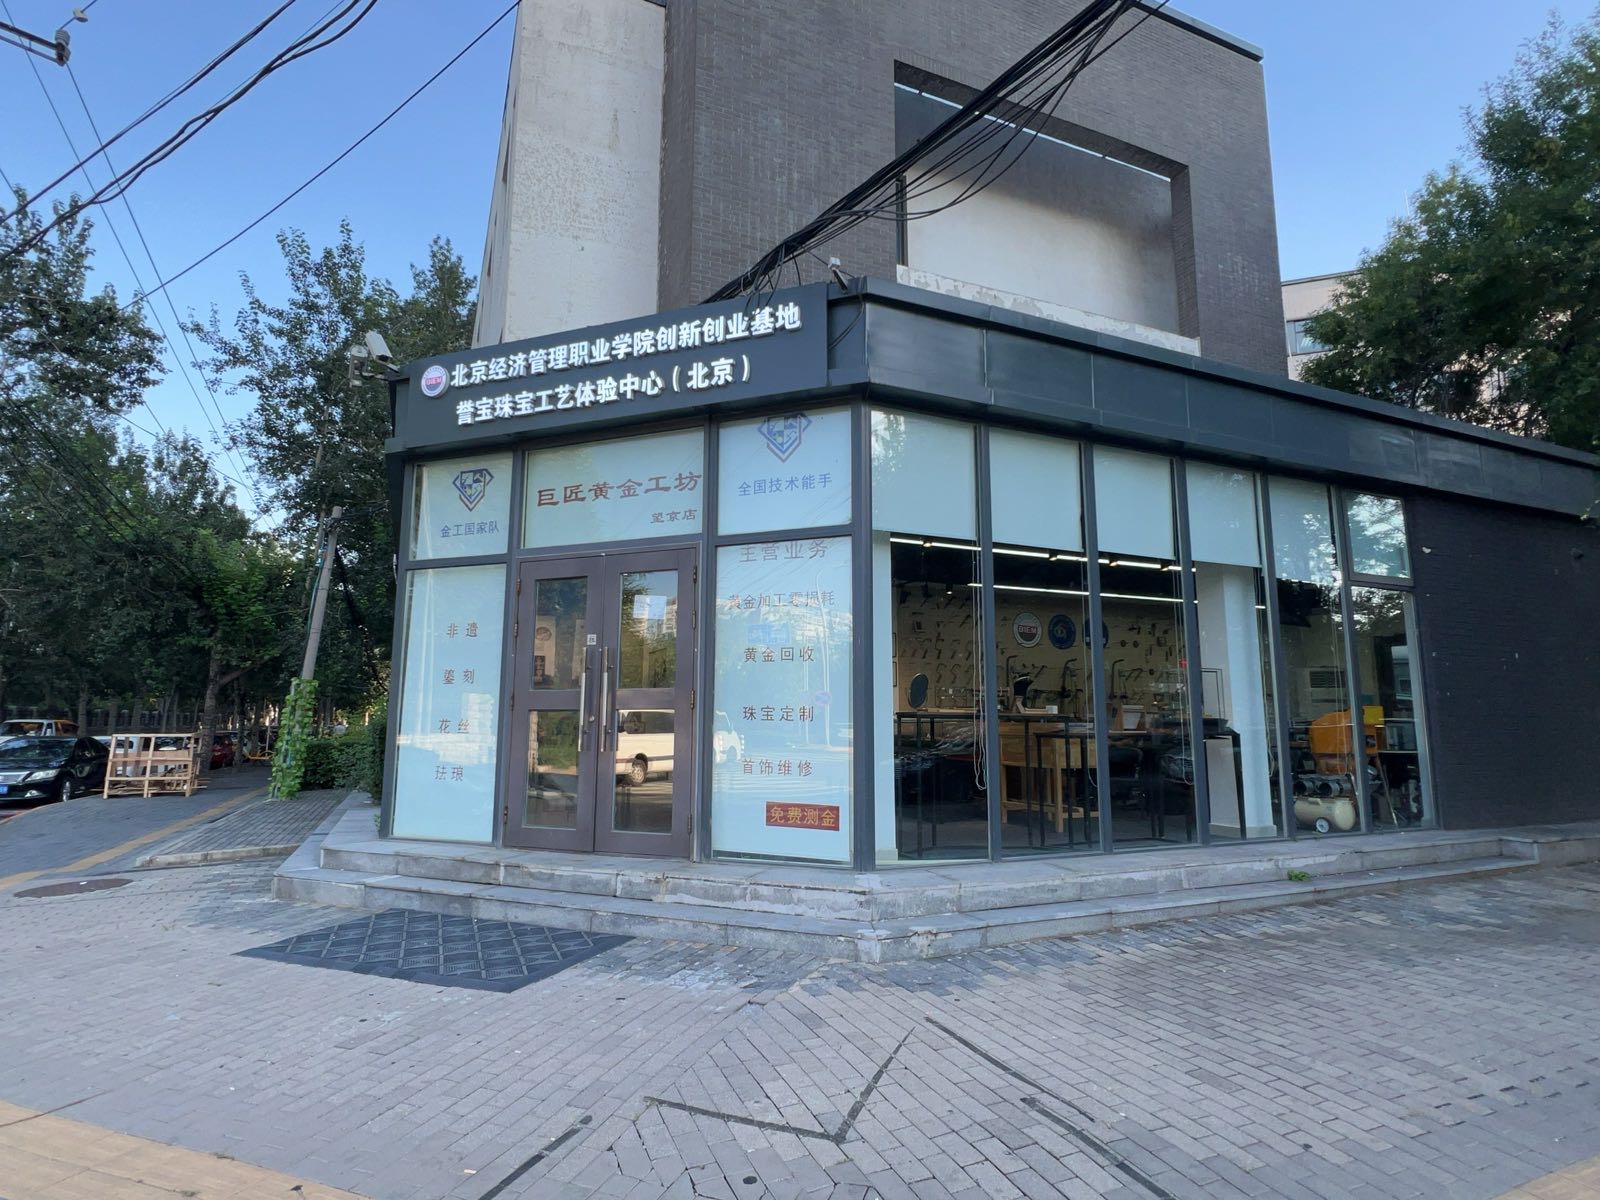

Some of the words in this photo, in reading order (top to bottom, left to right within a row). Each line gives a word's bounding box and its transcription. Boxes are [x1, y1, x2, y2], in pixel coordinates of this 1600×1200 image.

[450, 302, 801, 388] 北京经济管理职业学院创新创业基地
[537, 471, 702, 507] 巨匠黄金工坊
[738, 472, 832, 497] 全国技术能手
[650, 509, 697, 524] 望京店
[440, 520, 500, 538] 金工国家队
[739, 539, 828, 562] 主营业务
[728, 589, 834, 610] 黄金加工零损耗
[446, 622, 478, 639] 非遗
[744, 646, 815, 663] 黄金回收
[743, 705, 814, 722] 珠宝定制
[438, 718, 470, 734] 花丝
[742, 757, 813, 777] 首饰维修
[770, 806, 836, 827] 免费测金
